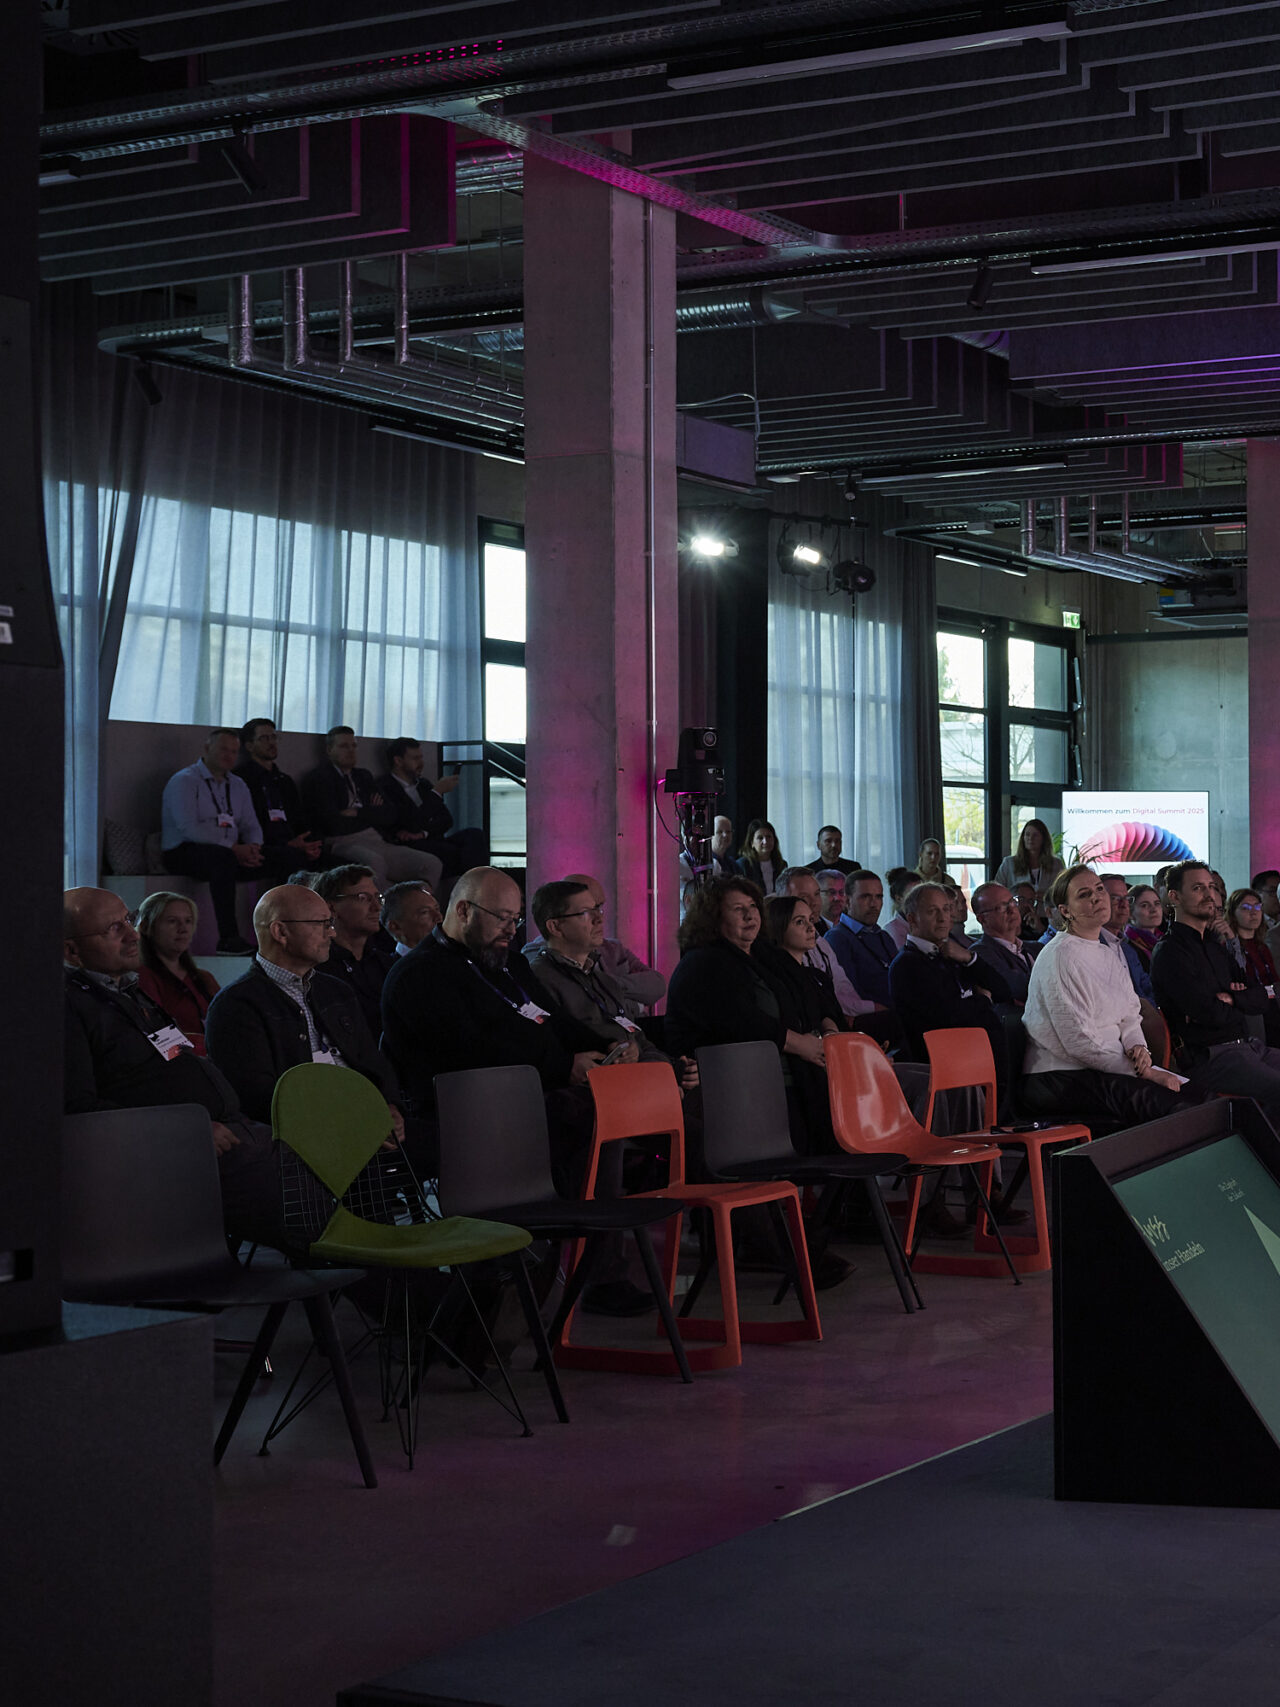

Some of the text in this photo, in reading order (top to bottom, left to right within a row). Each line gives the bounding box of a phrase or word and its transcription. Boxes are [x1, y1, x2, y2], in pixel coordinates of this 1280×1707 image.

[1067, 807, 1113, 815] Willkommen
[1132, 807, 1156, 816] Digital
[1157, 807, 1185, 815] Summit
[1187, 807, 1205, 815] 2025
[1175, 1241, 1206, 1264] Handeln
